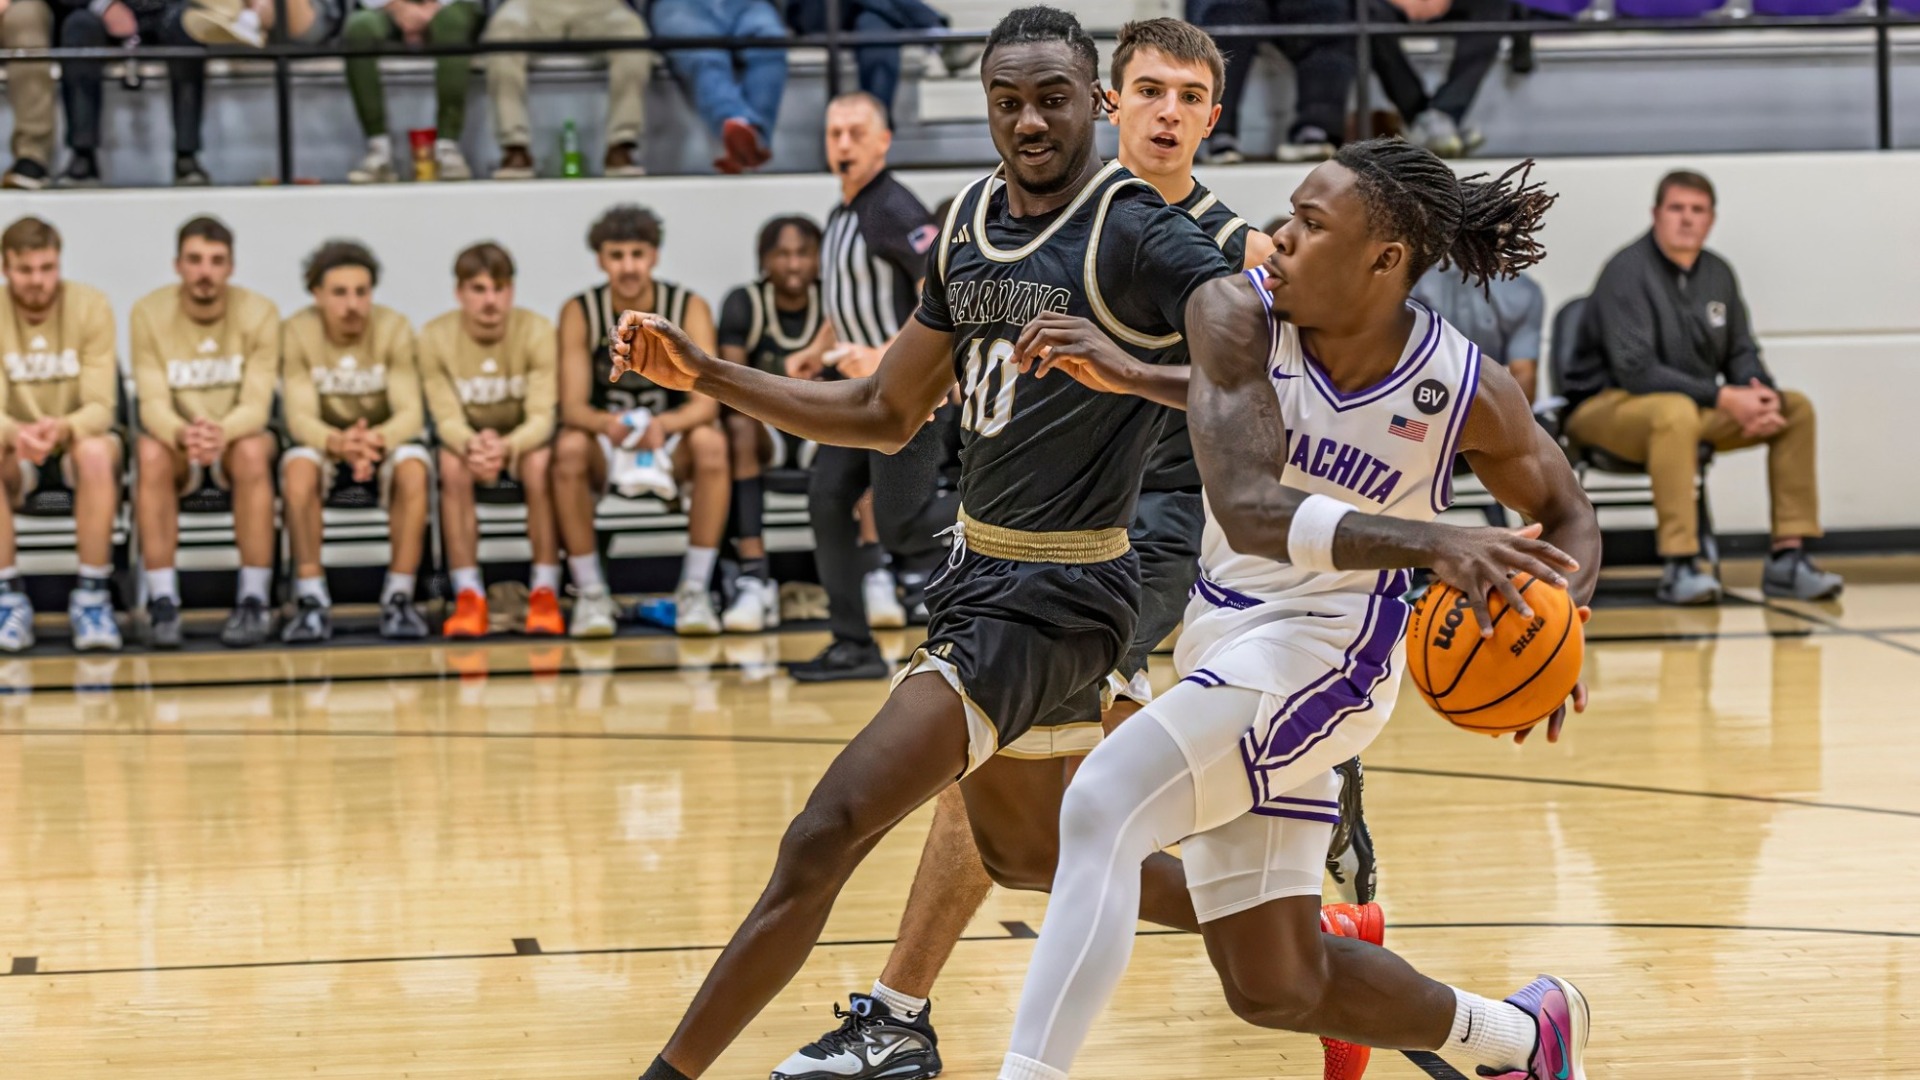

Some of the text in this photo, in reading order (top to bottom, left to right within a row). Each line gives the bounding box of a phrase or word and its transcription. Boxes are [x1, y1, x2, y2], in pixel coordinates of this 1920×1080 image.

[948, 278, 1071, 327] HARDING
[960, 337, 1020, 438] 10
[1417, 386, 1445, 407] BV
[1286, 429, 1403, 505] ACHITA
